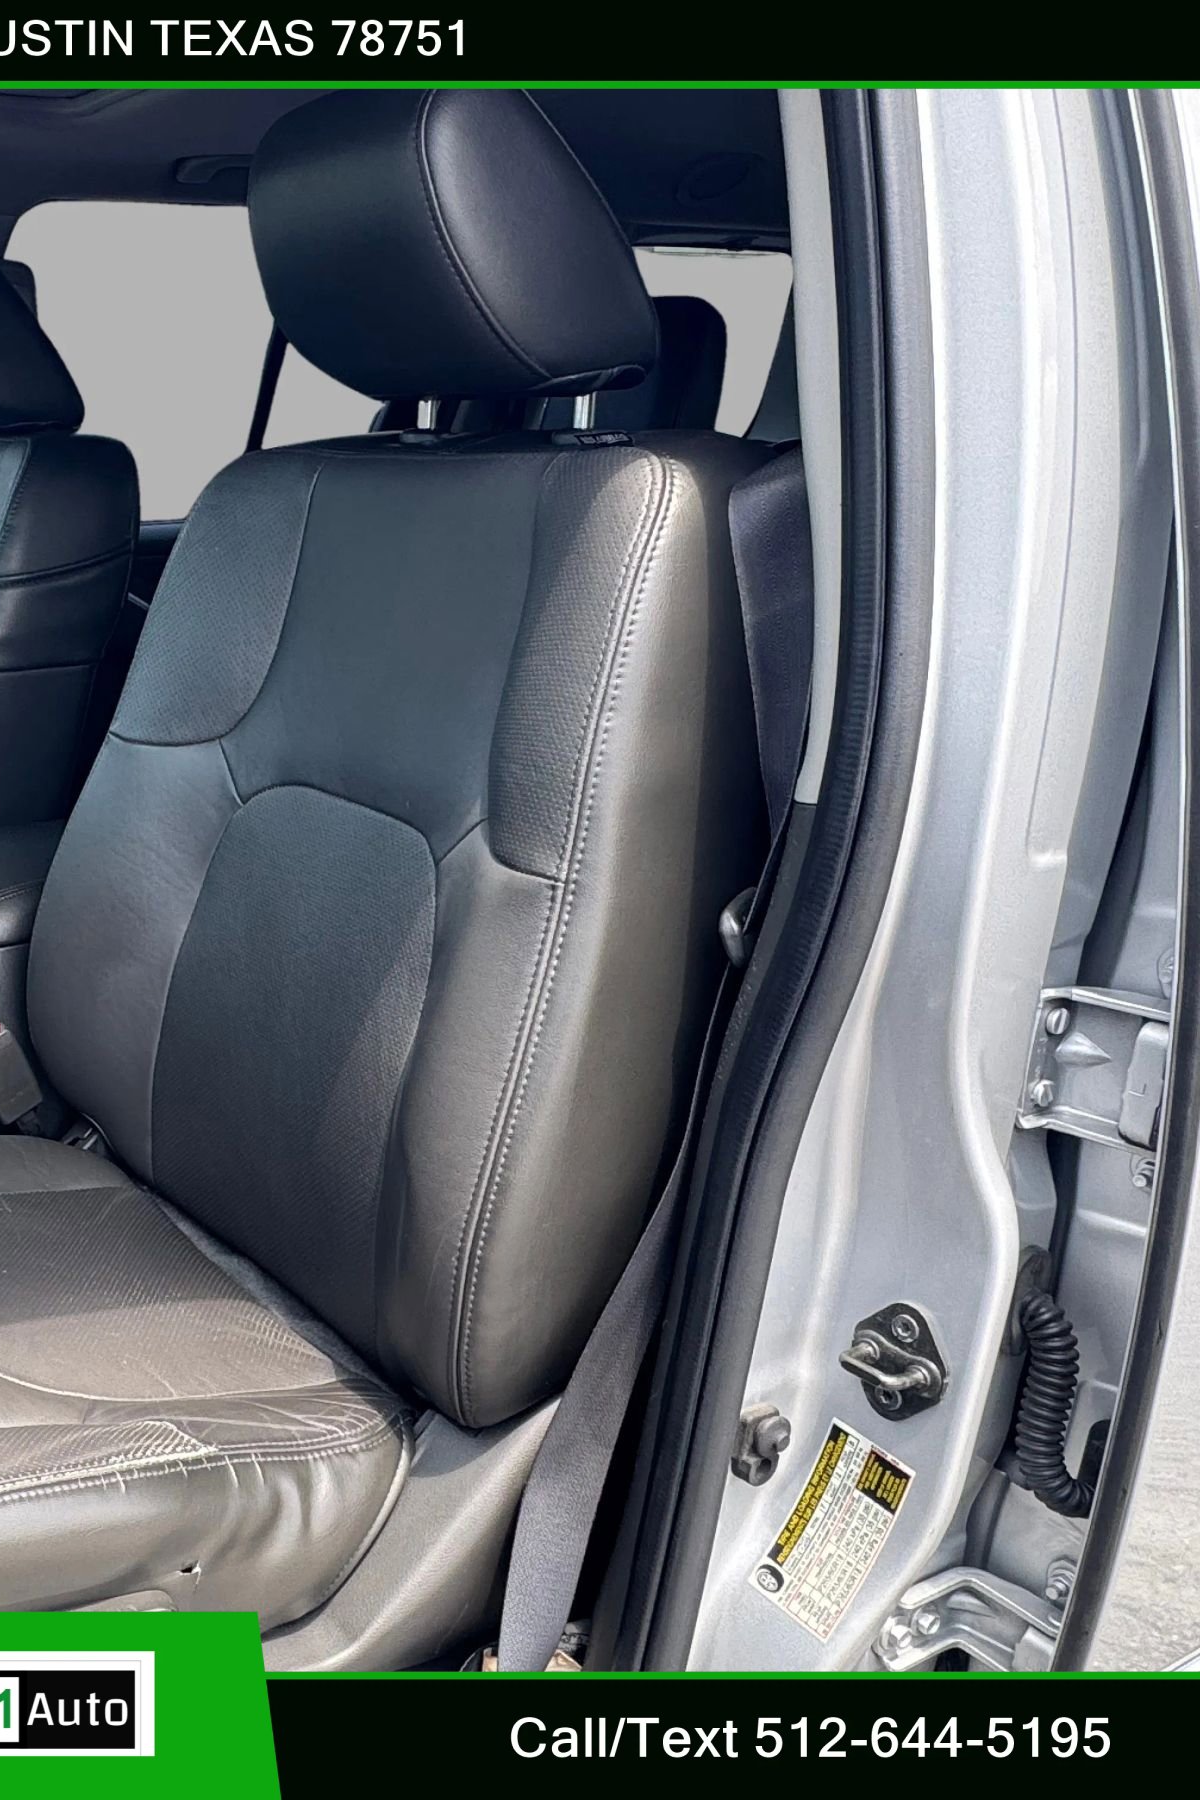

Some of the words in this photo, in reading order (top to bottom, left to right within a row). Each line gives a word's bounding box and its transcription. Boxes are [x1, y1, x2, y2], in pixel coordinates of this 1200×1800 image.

[786, 1513, 800, 1532] AND
[794, 1483, 816, 1516] LOADING
[809, 1439, 835, 1486] INFORMATION
